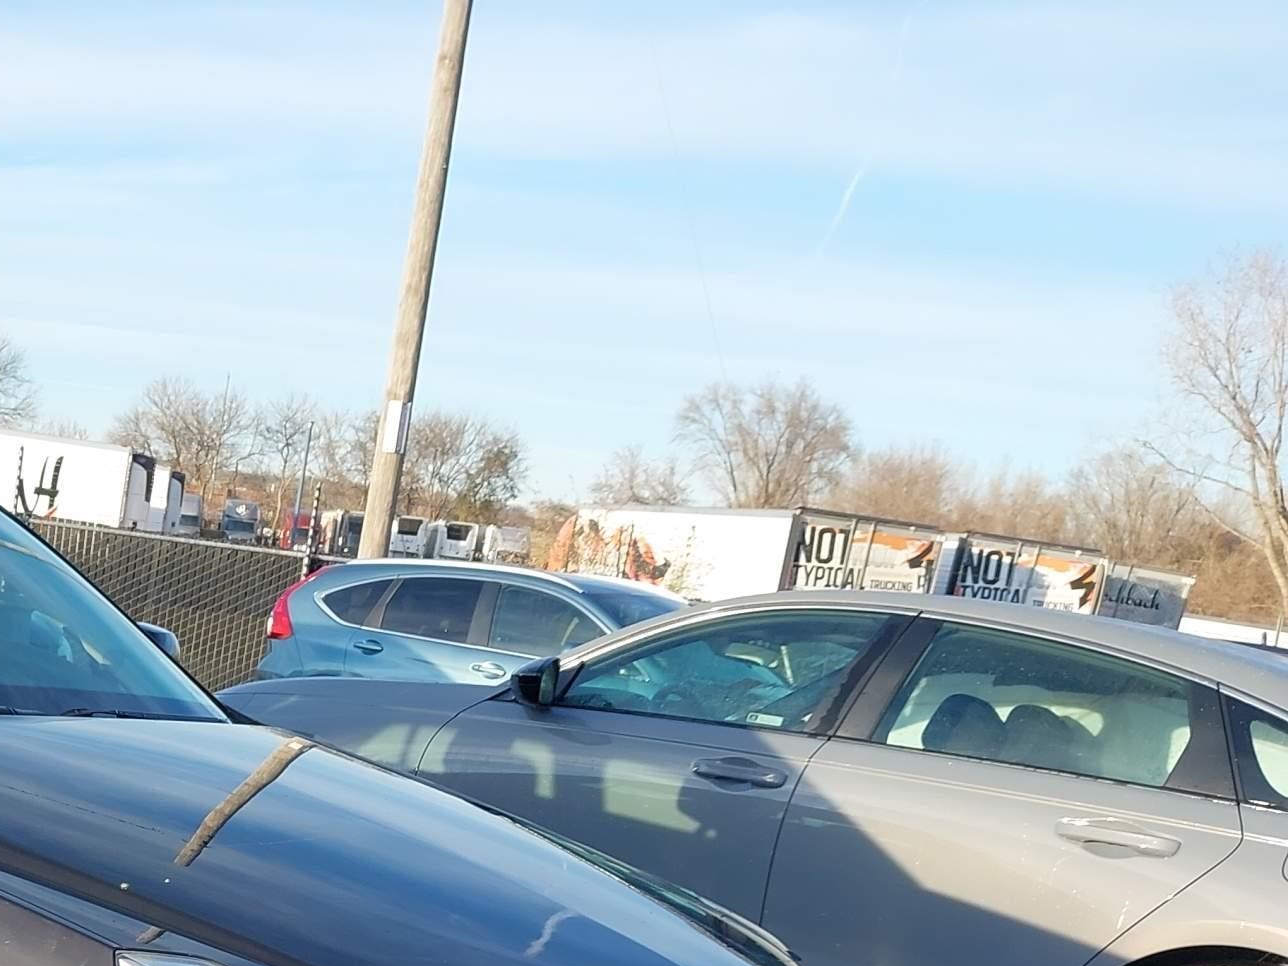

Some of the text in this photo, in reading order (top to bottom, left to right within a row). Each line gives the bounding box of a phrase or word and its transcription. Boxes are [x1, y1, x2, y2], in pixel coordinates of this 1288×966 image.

[793, 523, 851, 565] NOT
[793, 564, 864, 588] TYPICAL
[961, 547, 1021, 586] NOT
[870, 579, 913, 592] TRUCKING
